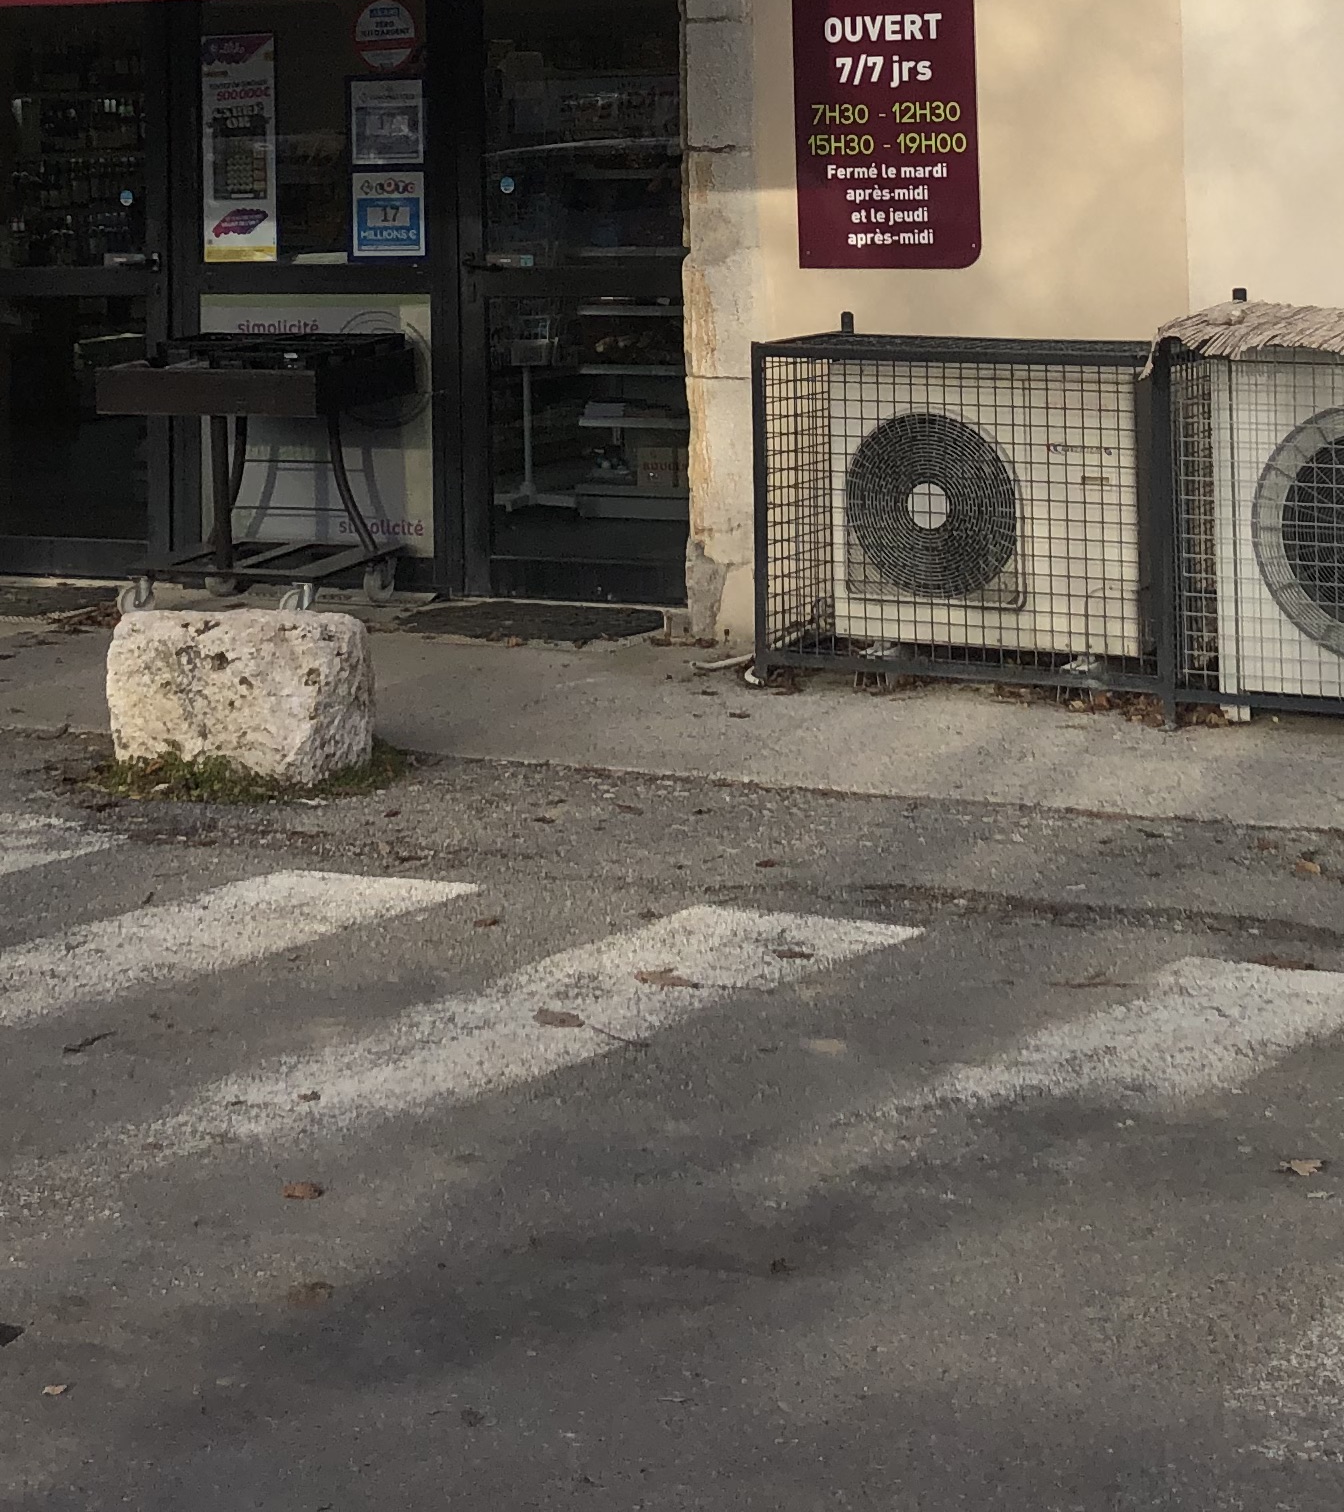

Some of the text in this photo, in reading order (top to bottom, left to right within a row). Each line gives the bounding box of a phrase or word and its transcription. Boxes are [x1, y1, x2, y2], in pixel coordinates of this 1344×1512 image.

[824, 12, 942, 44] OUVERT
[835, 54, 933, 88] 7/7 jrs
[811, 103, 869, 126] 7H30
[891, 101, 961, 124] 12H30
[808, 134, 875, 156] 15H30
[896, 132, 967, 154] 19H00
[827, 162, 948, 180] Fermé le mardi
[845, 184, 929, 205] après-midi
[380, 205, 400, 223] 17
[851, 206, 929, 226] et le jeudi
[360, 229, 408, 240] MILLIONS
[847, 228, 934, 249] après-midi
